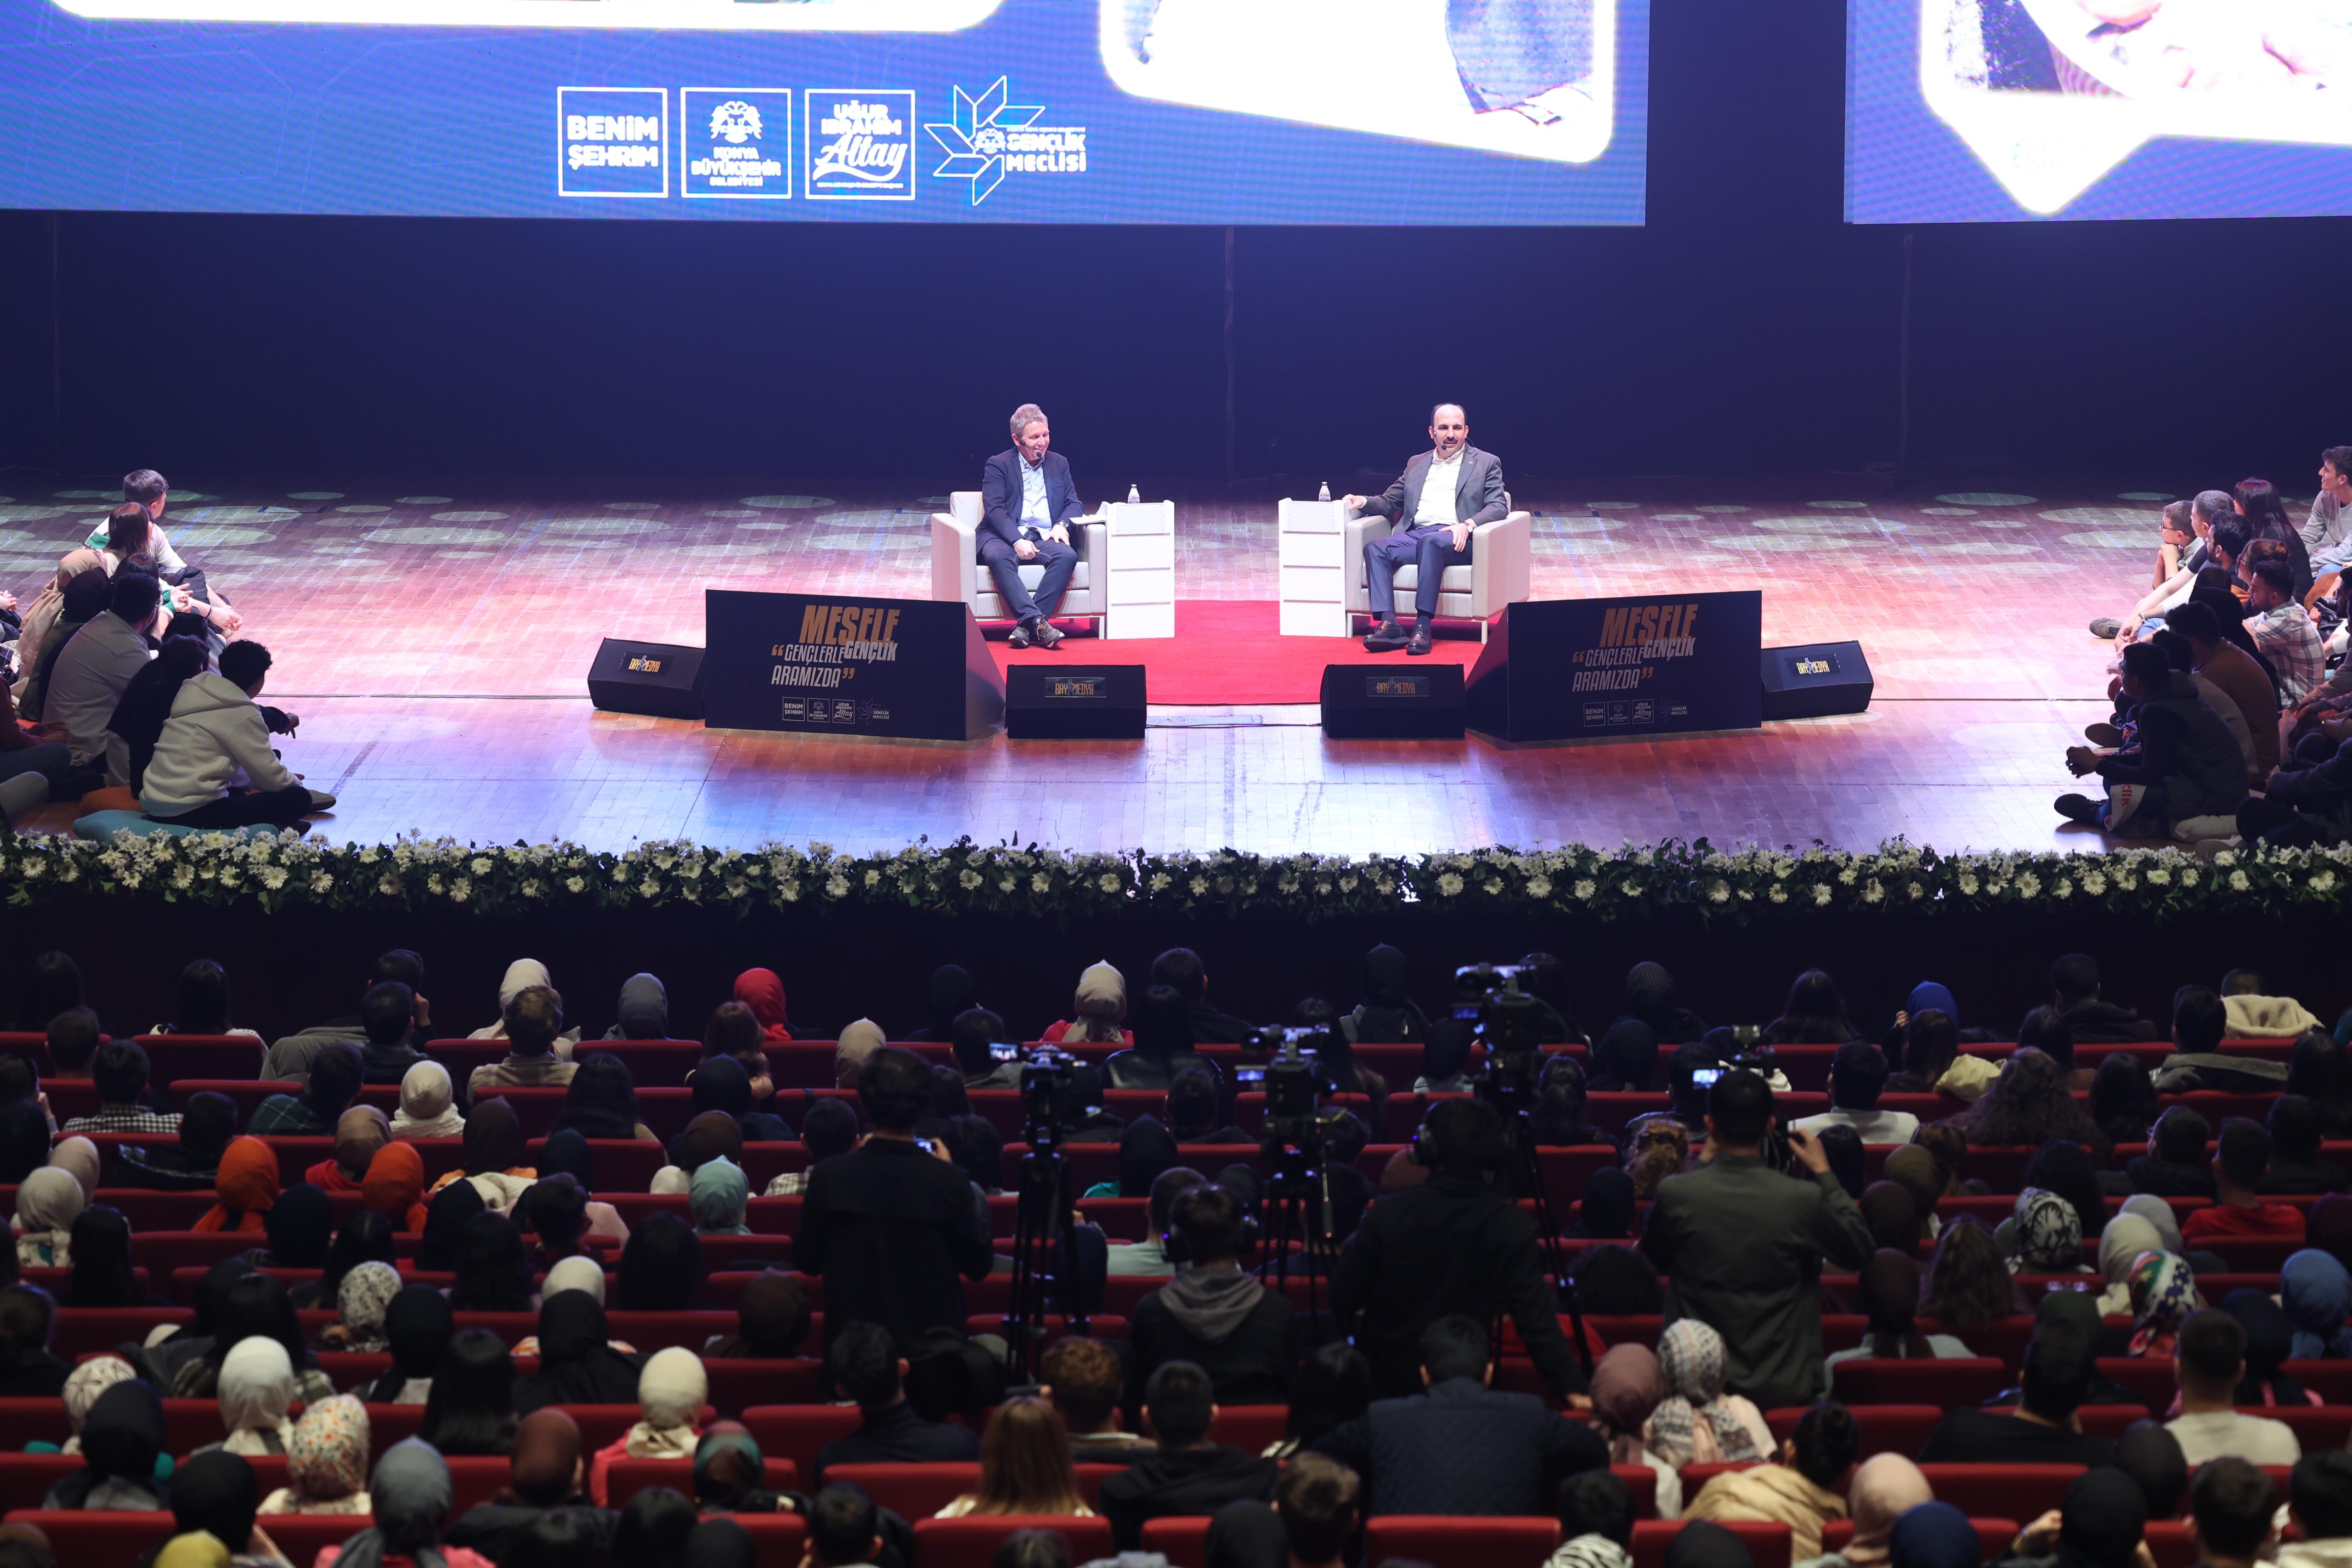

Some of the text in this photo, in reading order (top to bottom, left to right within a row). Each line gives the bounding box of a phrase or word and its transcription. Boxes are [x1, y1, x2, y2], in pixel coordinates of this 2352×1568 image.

[834, 100, 889, 120] UĞUR
[567, 115, 658, 141] BENİM
[713, 147, 759, 159] KONYA
[1006, 131, 1086, 154] GENÇLİK
[568, 145, 658, 170] ŞEHRİM
[813, 133, 908, 181] Altay
[799, 605, 900, 647] MESELE
[1600, 604, 1698, 647] MESELE
[843, 638, 898, 664] GENÇLİK
[1643, 634, 1696, 661] GENÇLİK
[834, 709, 853, 720] Altay
